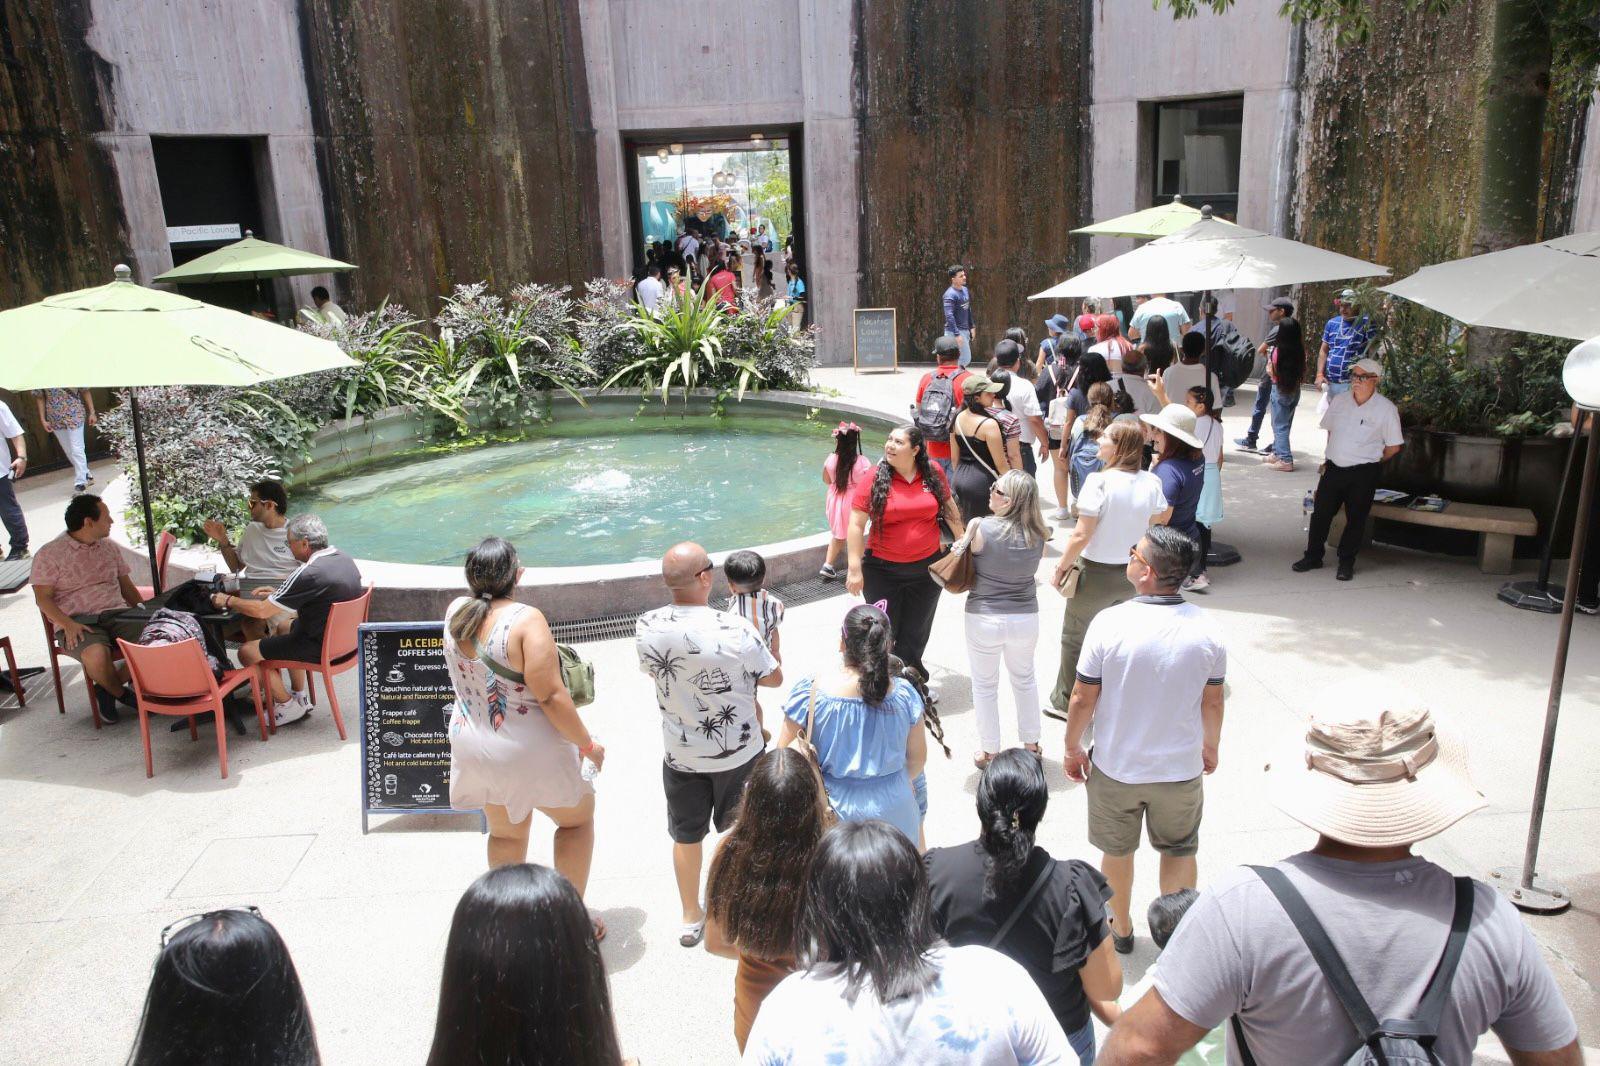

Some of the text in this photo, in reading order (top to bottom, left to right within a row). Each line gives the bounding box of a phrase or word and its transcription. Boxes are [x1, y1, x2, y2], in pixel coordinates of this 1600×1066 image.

[181, 225, 240, 235] Pacific Lounge
[400, 638, 445, 648] LA CEIBA
[397, 649, 426, 657] COFFEE
[414, 663, 441, 671] Expresso
[382, 709, 403, 717] Frappe
[383, 751, 397, 759] Café
